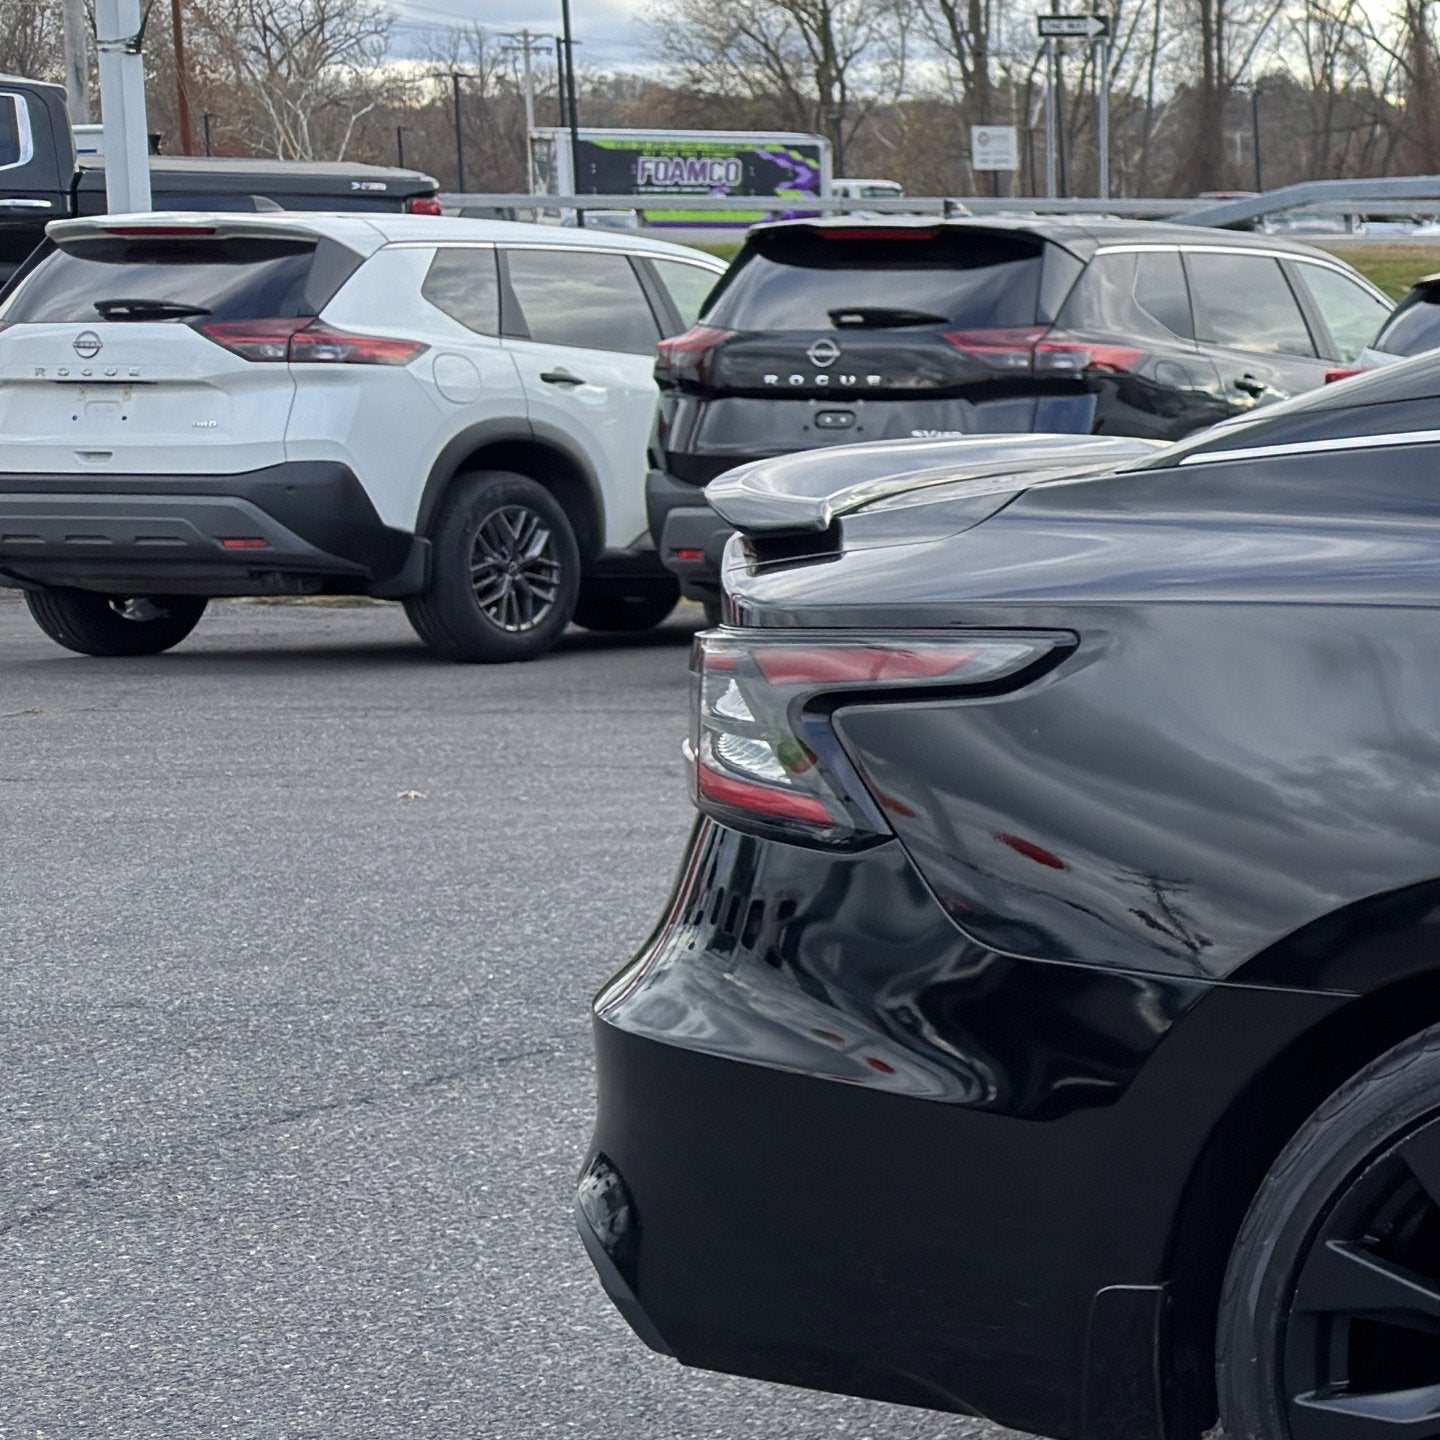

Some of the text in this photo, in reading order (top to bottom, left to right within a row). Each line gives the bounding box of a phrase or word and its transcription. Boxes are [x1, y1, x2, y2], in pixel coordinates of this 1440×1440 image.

[637, 156, 743, 186] FOAMCO
[35, 367, 141, 377] ROGUE
[764, 374, 882, 386] ROGUE
